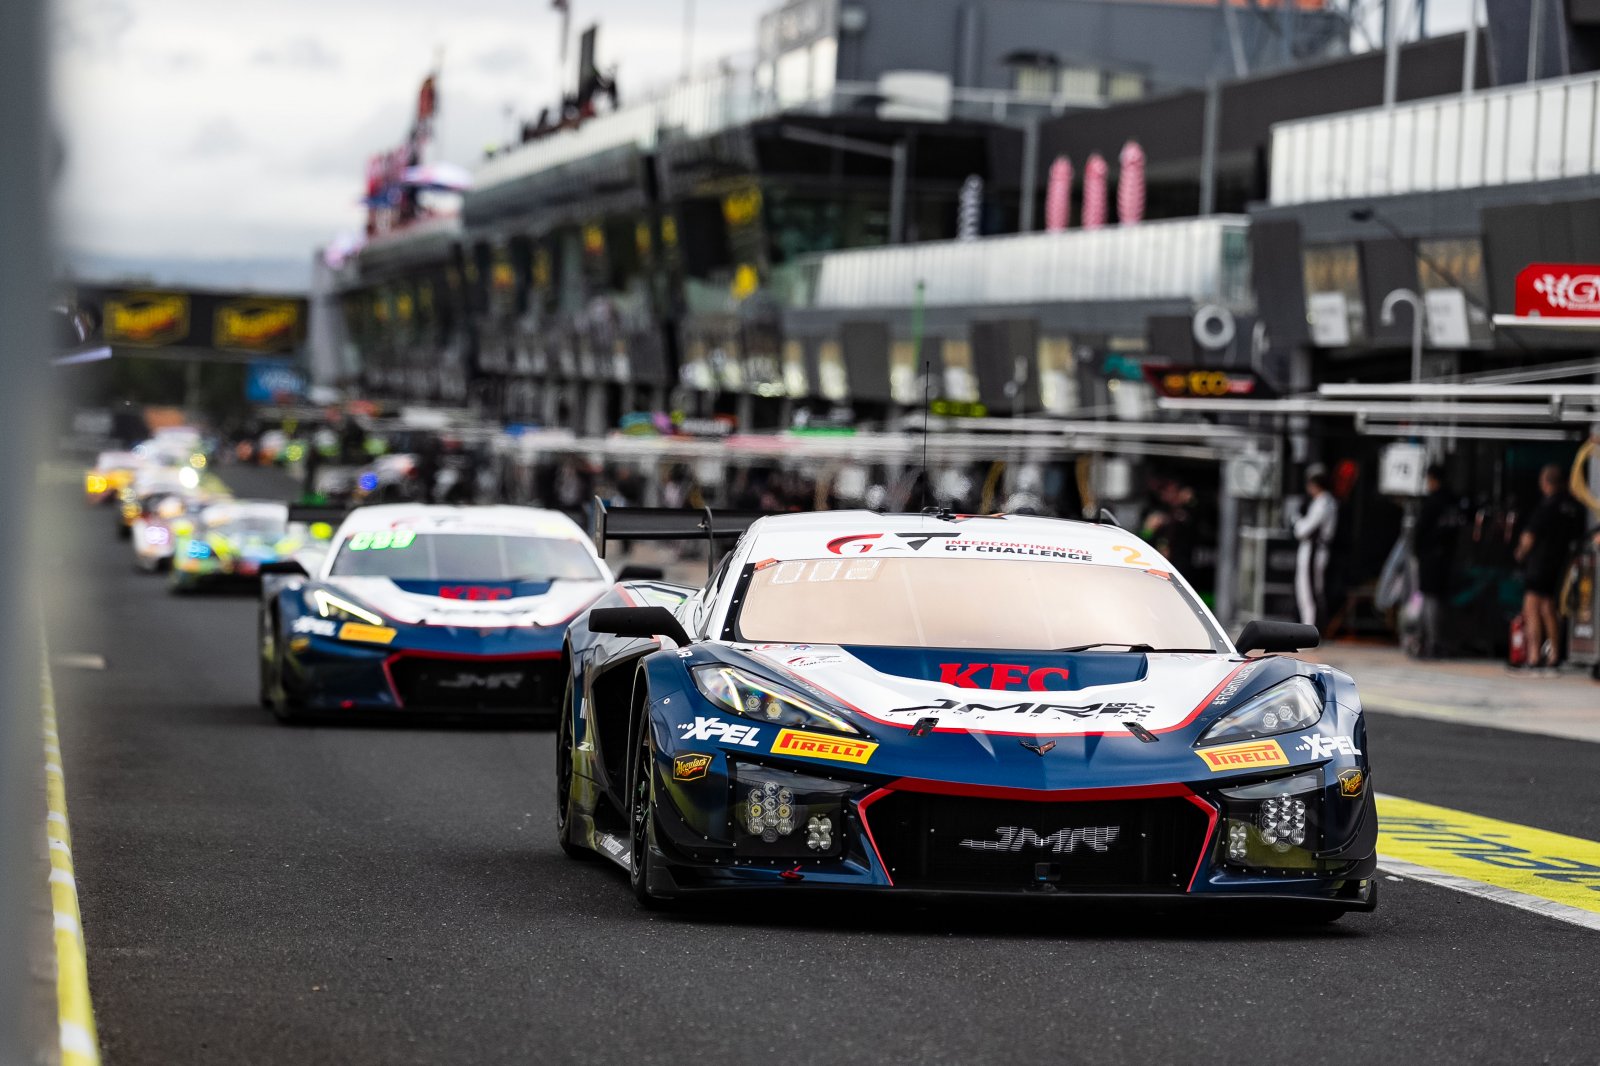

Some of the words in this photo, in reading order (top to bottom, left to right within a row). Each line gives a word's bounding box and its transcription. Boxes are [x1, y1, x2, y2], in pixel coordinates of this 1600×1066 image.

[945, 539, 1090, 556] INTERCONTINENTAL
[945, 544, 971, 552] GT
[976, 545, 1093, 562] CHALLENGE
[1111, 545, 1152, 567] 2
[939, 662, 1070, 692] KFC
[679, 716, 762, 747] XPEL
[779, 732, 869, 758] PIRELLI
[1205, 743, 1281, 767] PIRELLI
[1300, 732, 1363, 761] XPEL
[958, 825, 1121, 854] JMR
